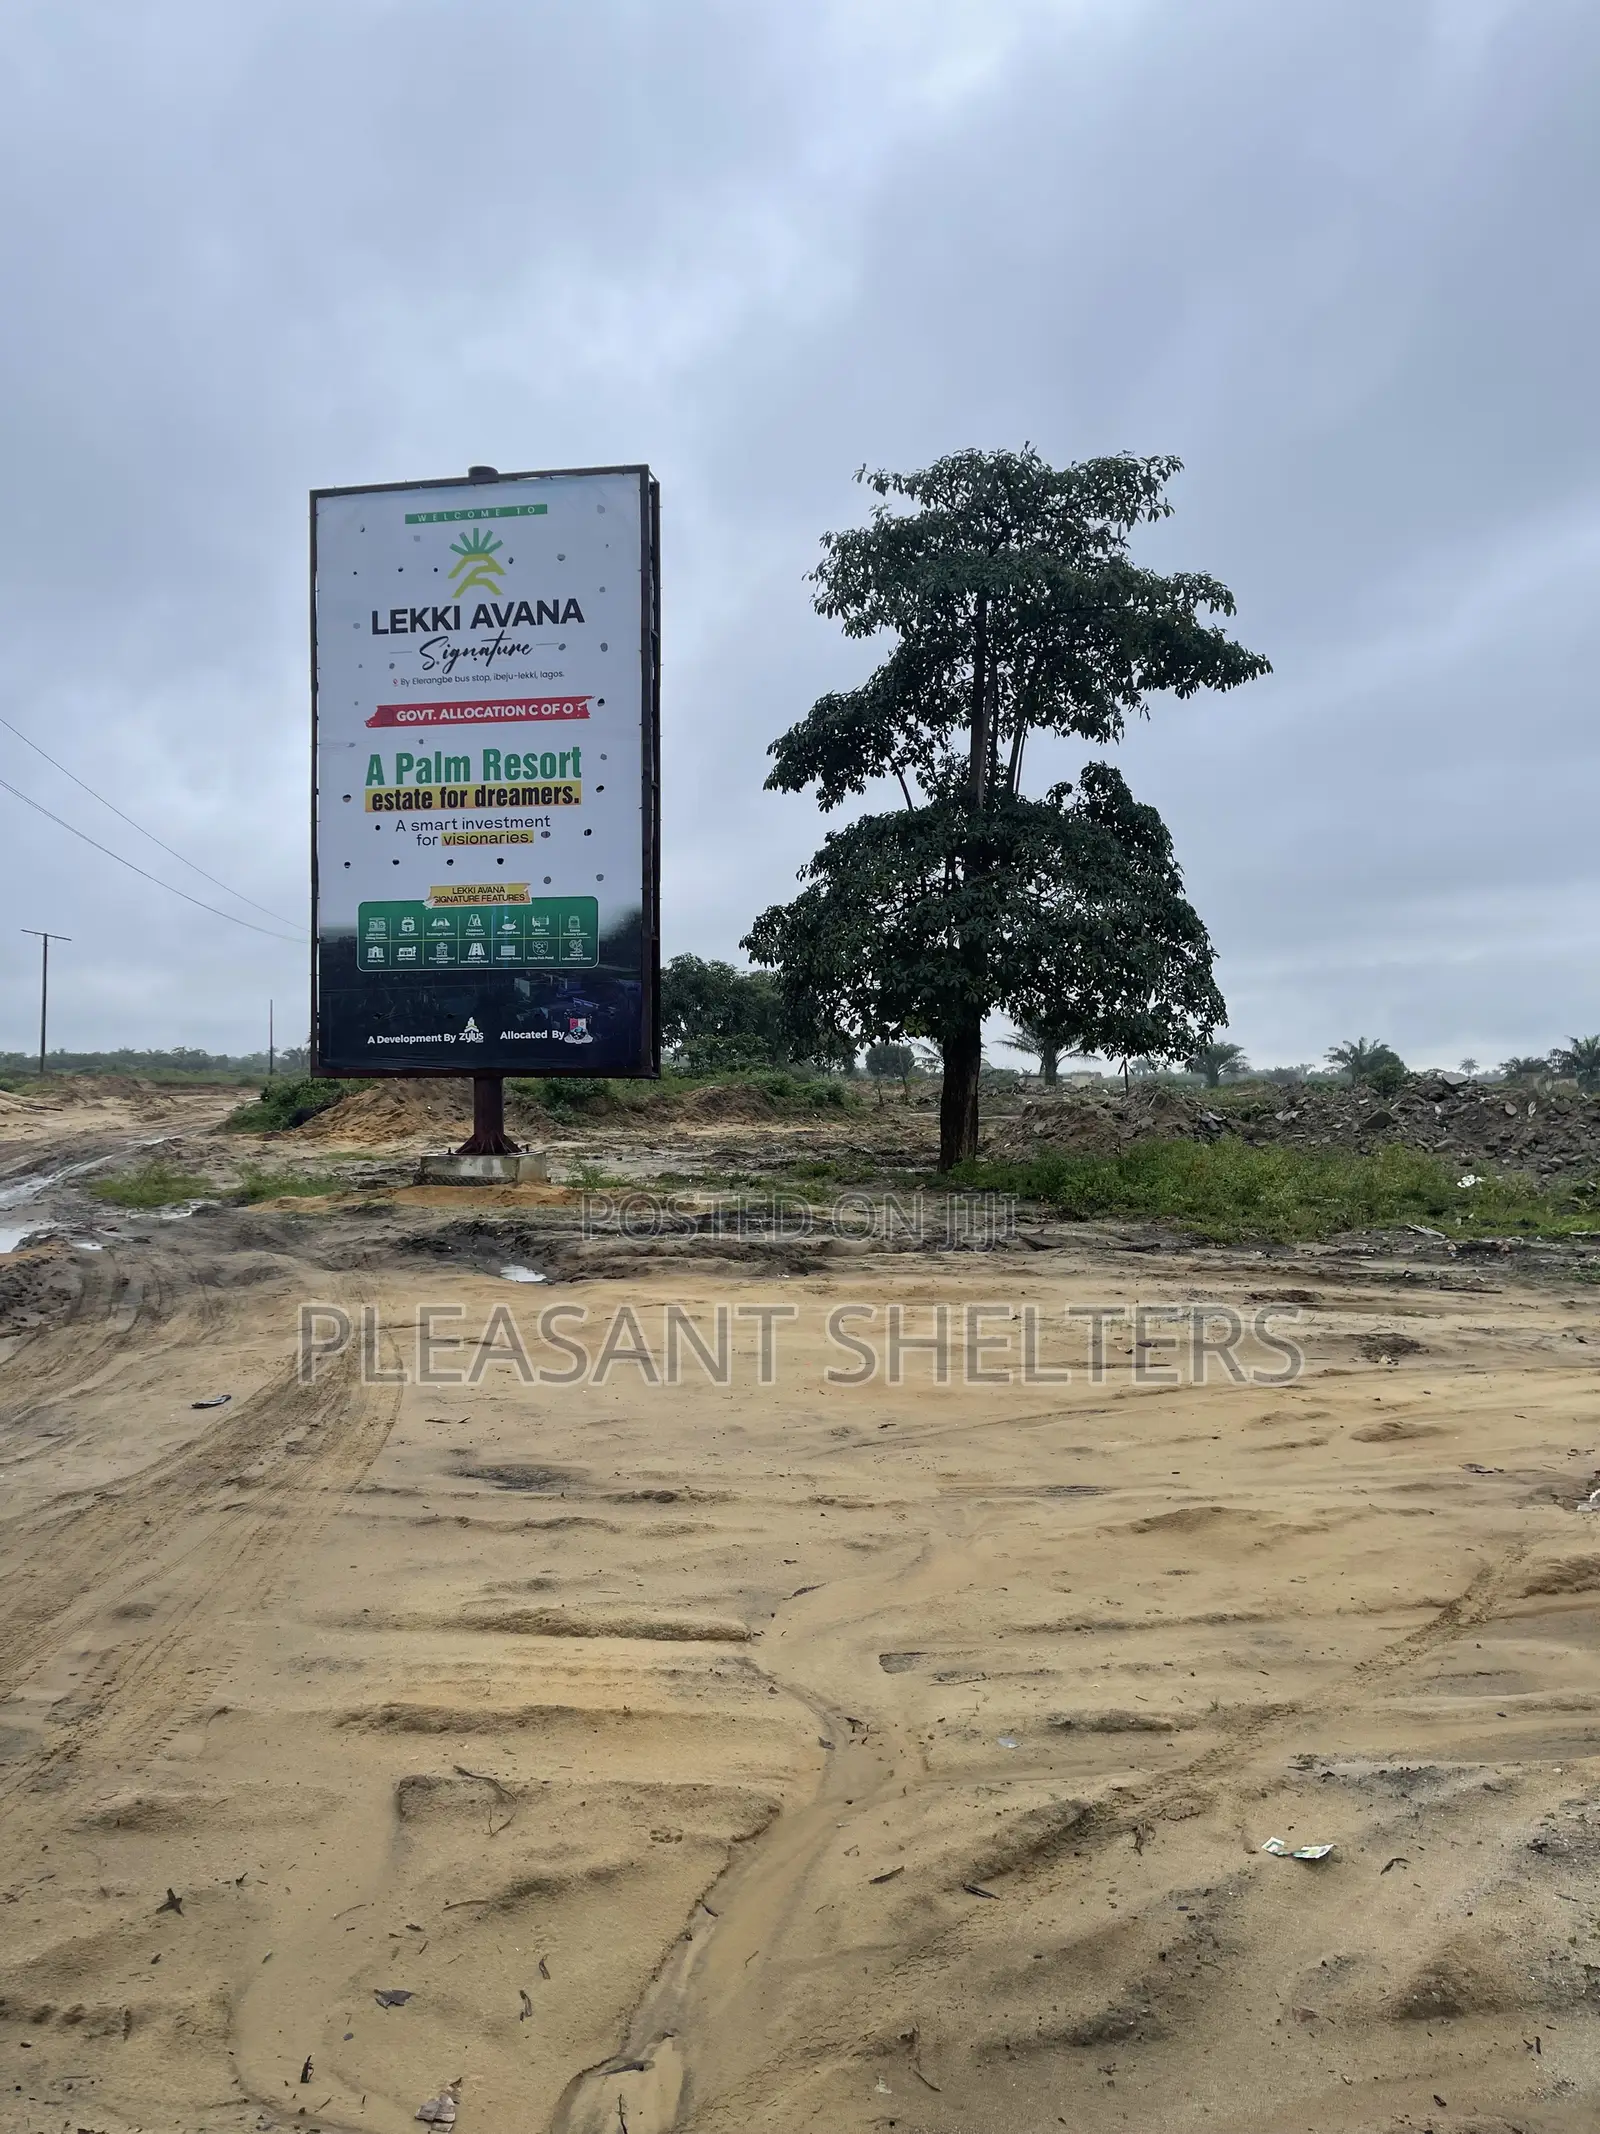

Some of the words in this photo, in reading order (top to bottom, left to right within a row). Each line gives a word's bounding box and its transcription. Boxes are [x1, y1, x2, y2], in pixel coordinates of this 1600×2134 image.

[418, 508, 500, 522] WELCOME
[516, 506, 535, 515] TO
[371, 605, 460, 635] LEKKI
[469, 598, 585, 630] AVANA
[419, 629, 533, 674] Signature
[400, 678, 410, 687] By
[455, 675, 470, 683] bus
[472, 673, 492, 684] stop,
[540, 670, 565, 680] lagos.
[396, 710, 437, 722] GOVT.
[439, 705, 526, 720] ALLOCATION
[528, 704, 539, 715] C
[541, 703, 560, 715] OF
[562, 703, 573, 714] O
[365, 754, 385, 786] A
[396, 751, 471, 785] Palm
[482, 747, 582, 781] Resort
[372, 788, 433, 811] estate
[439, 786, 468, 808] for
[474, 785, 580, 808] dreamers.
[395, 819, 406, 832] A
[411, 817, 458, 832] smart
[462, 815, 551, 830] investment
[416, 833, 438, 846] for
[443, 830, 533, 845] visionaries.
[433, 894, 480, 903] SIGNATURE
[481, 894, 525, 902] FEATURES
[452, 886, 476, 894] LEKKI
[367, 1035, 375, 1044] A
[377, 1034, 442, 1044] Development
[443, 1033, 456, 1043] By
[500, 1030, 547, 1040] Allocated
[552, 1030, 565, 1040] By
